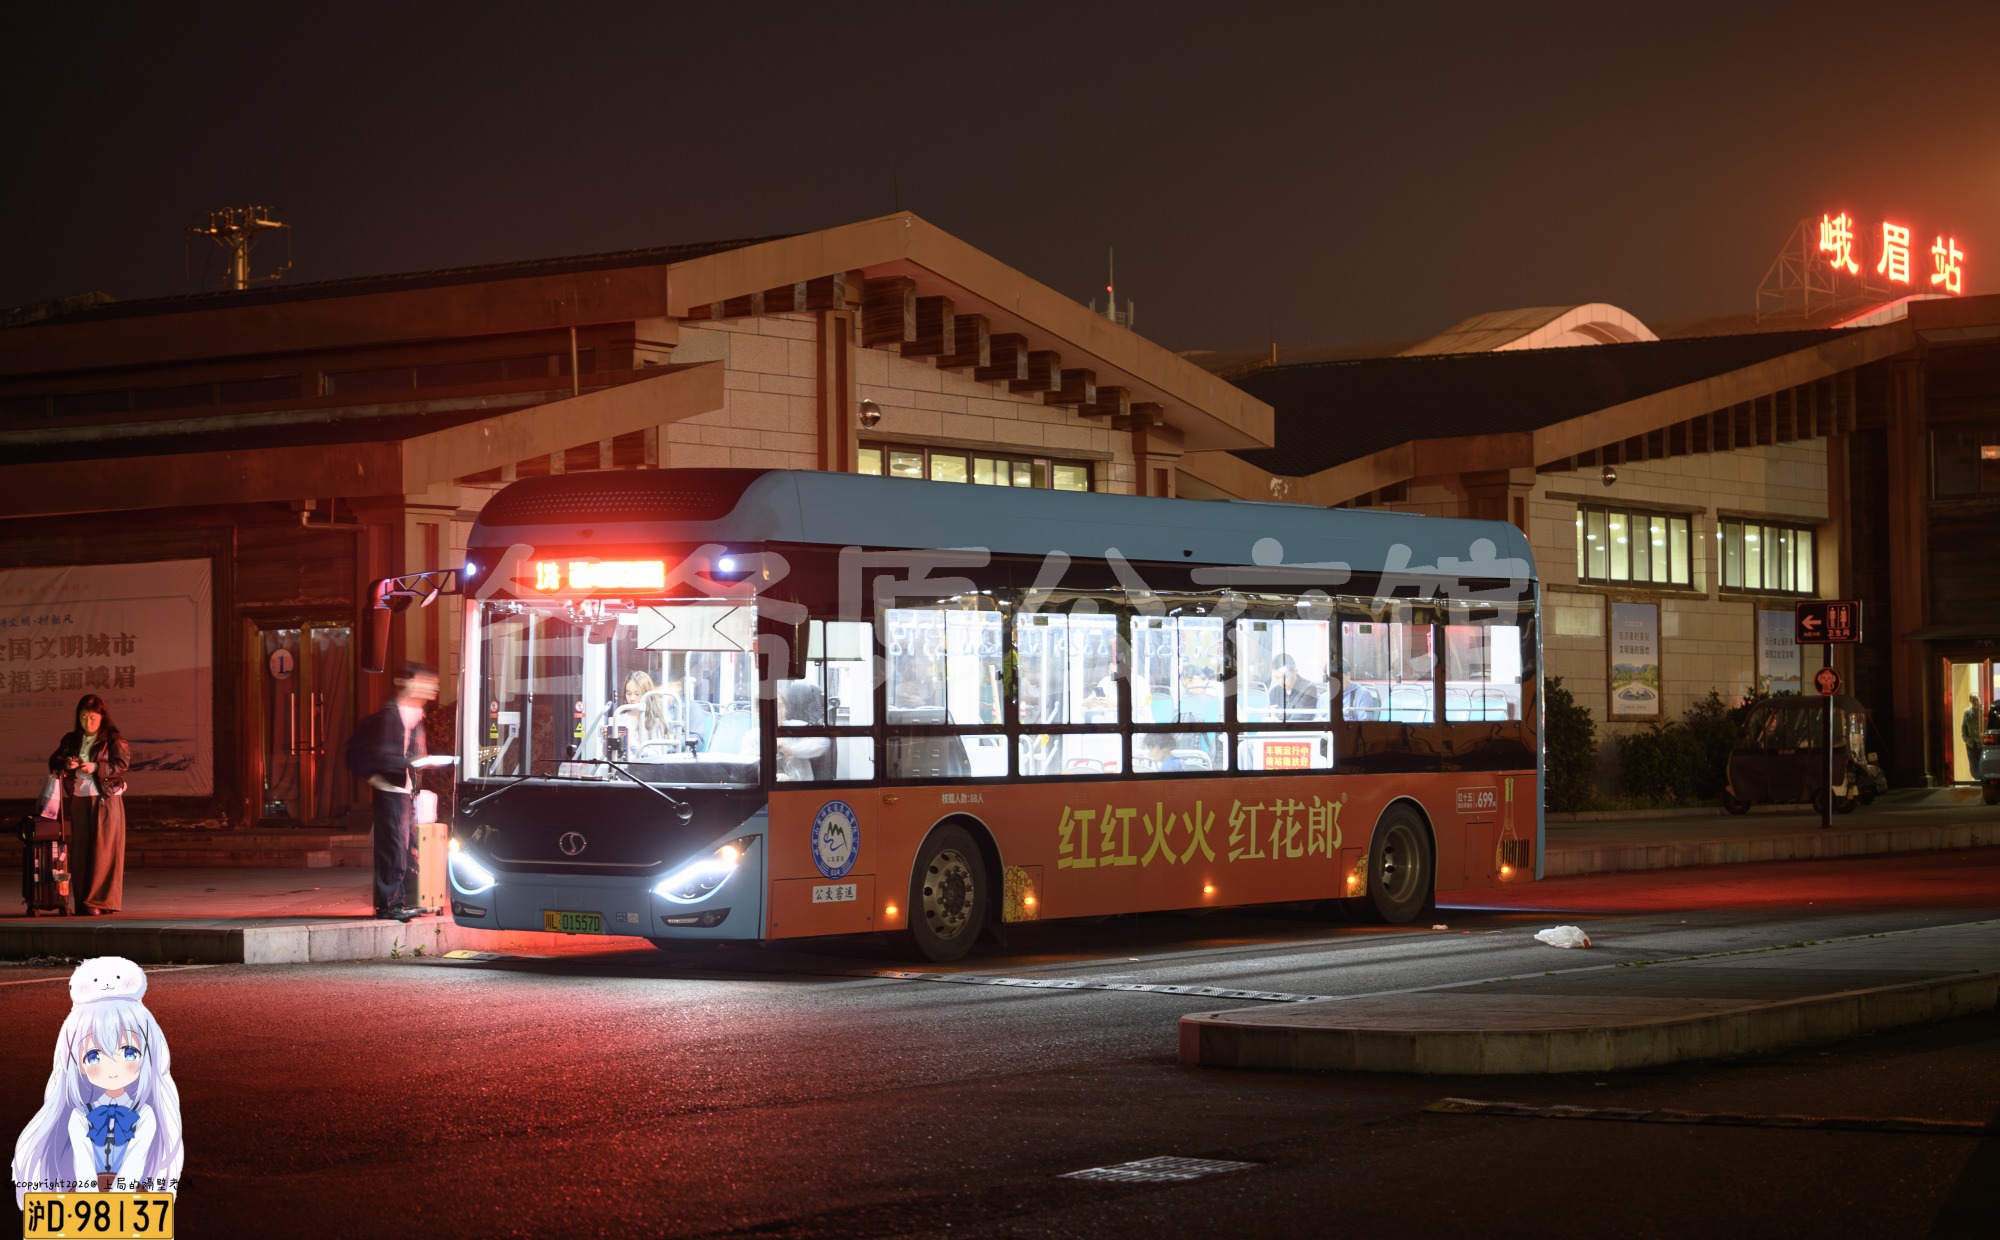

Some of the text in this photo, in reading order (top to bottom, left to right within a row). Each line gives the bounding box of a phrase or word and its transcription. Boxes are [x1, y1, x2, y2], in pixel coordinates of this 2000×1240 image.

[1819, 212, 1964, 295] 峨眉站
[1827, 629, 1851, 637] 卫生间
[278, 654, 289, 674] 1
[1265, 745, 1310, 756] 车辆运行中
[1265, 757, 1310, 767] 请站稳扶好
[1458, 793, 1473, 802] 红十五
[1058, 796, 1342, 869] 红红火火 红花郎
[815, 886, 854, 901] 公交客运
